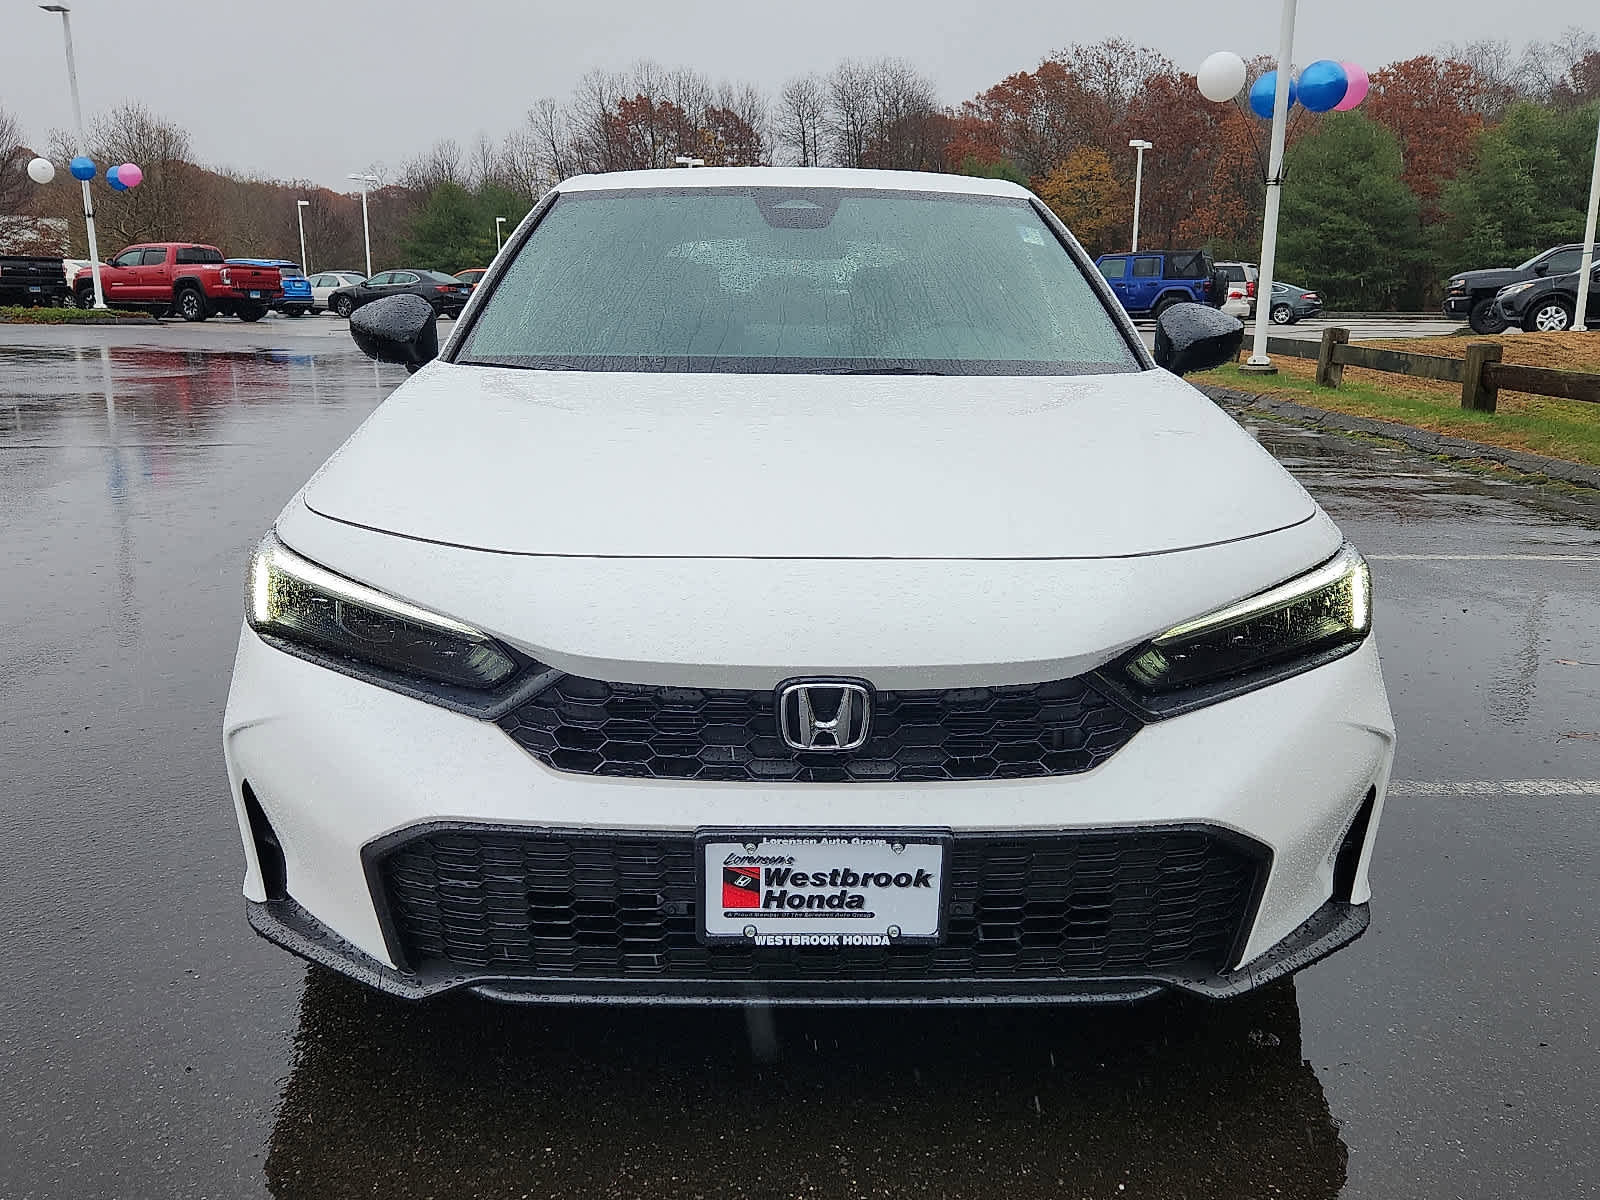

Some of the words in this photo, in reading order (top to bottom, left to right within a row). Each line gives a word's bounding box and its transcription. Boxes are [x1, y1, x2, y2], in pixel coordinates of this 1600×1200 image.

[762, 837, 819, 846] Lorensen
[820, 837, 848, 846] Auto
[851, 837, 887, 846] Group
[723, 852, 795, 866] Lorensen's
[764, 867, 934, 888] Westbrook
[762, 889, 865, 910] Honda
[754, 935, 839, 946] WESTBROOK
[842, 935, 891, 946] HONDA
